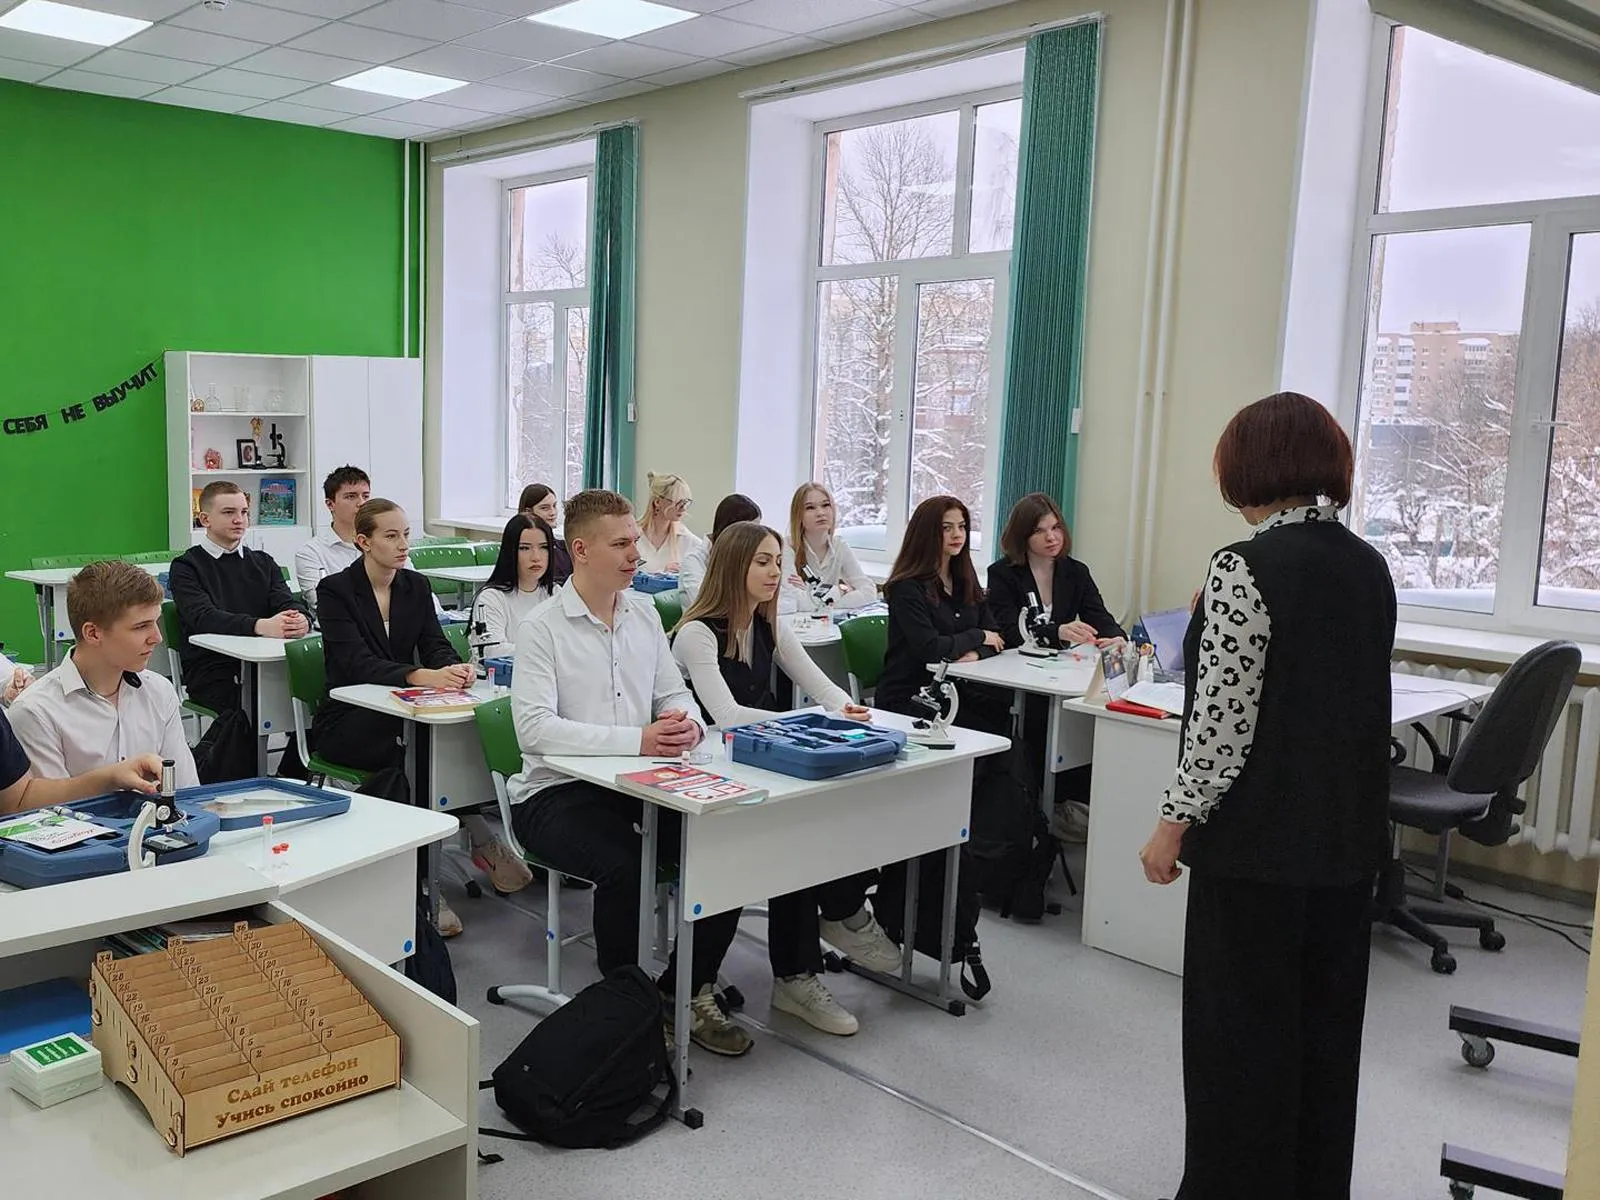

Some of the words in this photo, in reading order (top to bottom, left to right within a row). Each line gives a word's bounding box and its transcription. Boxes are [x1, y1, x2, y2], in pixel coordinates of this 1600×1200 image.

[3, 413, 48, 435] СЕБЯ
[60, 403, 87, 424] НЕ
[92, 363, 158, 412] ВЫУЧИТ
[251, 942, 262, 950] 30
[99, 953, 111, 963] 34
[258, 950, 268, 959] 27
[184, 957, 195, 965] 29
[106, 962, 117, 971] 31
[274, 969, 284, 978] 21
[198, 976, 209, 984] 23
[205, 986, 216, 995] 20
[126, 993, 138, 1002] 22
[214, 996, 224, 1005] 17
[300, 999, 308, 1007] 12
[133, 1004, 143, 1012] 19
[230, 1016, 239, 1024] 11
[154, 1035, 166, 1045] 10
[227, 1080, 275, 1104] Сдай
[280, 1057, 359, 1089] телефон
[215, 1102, 275, 1129] Учись
[280, 1074, 369, 1109] спокойно
